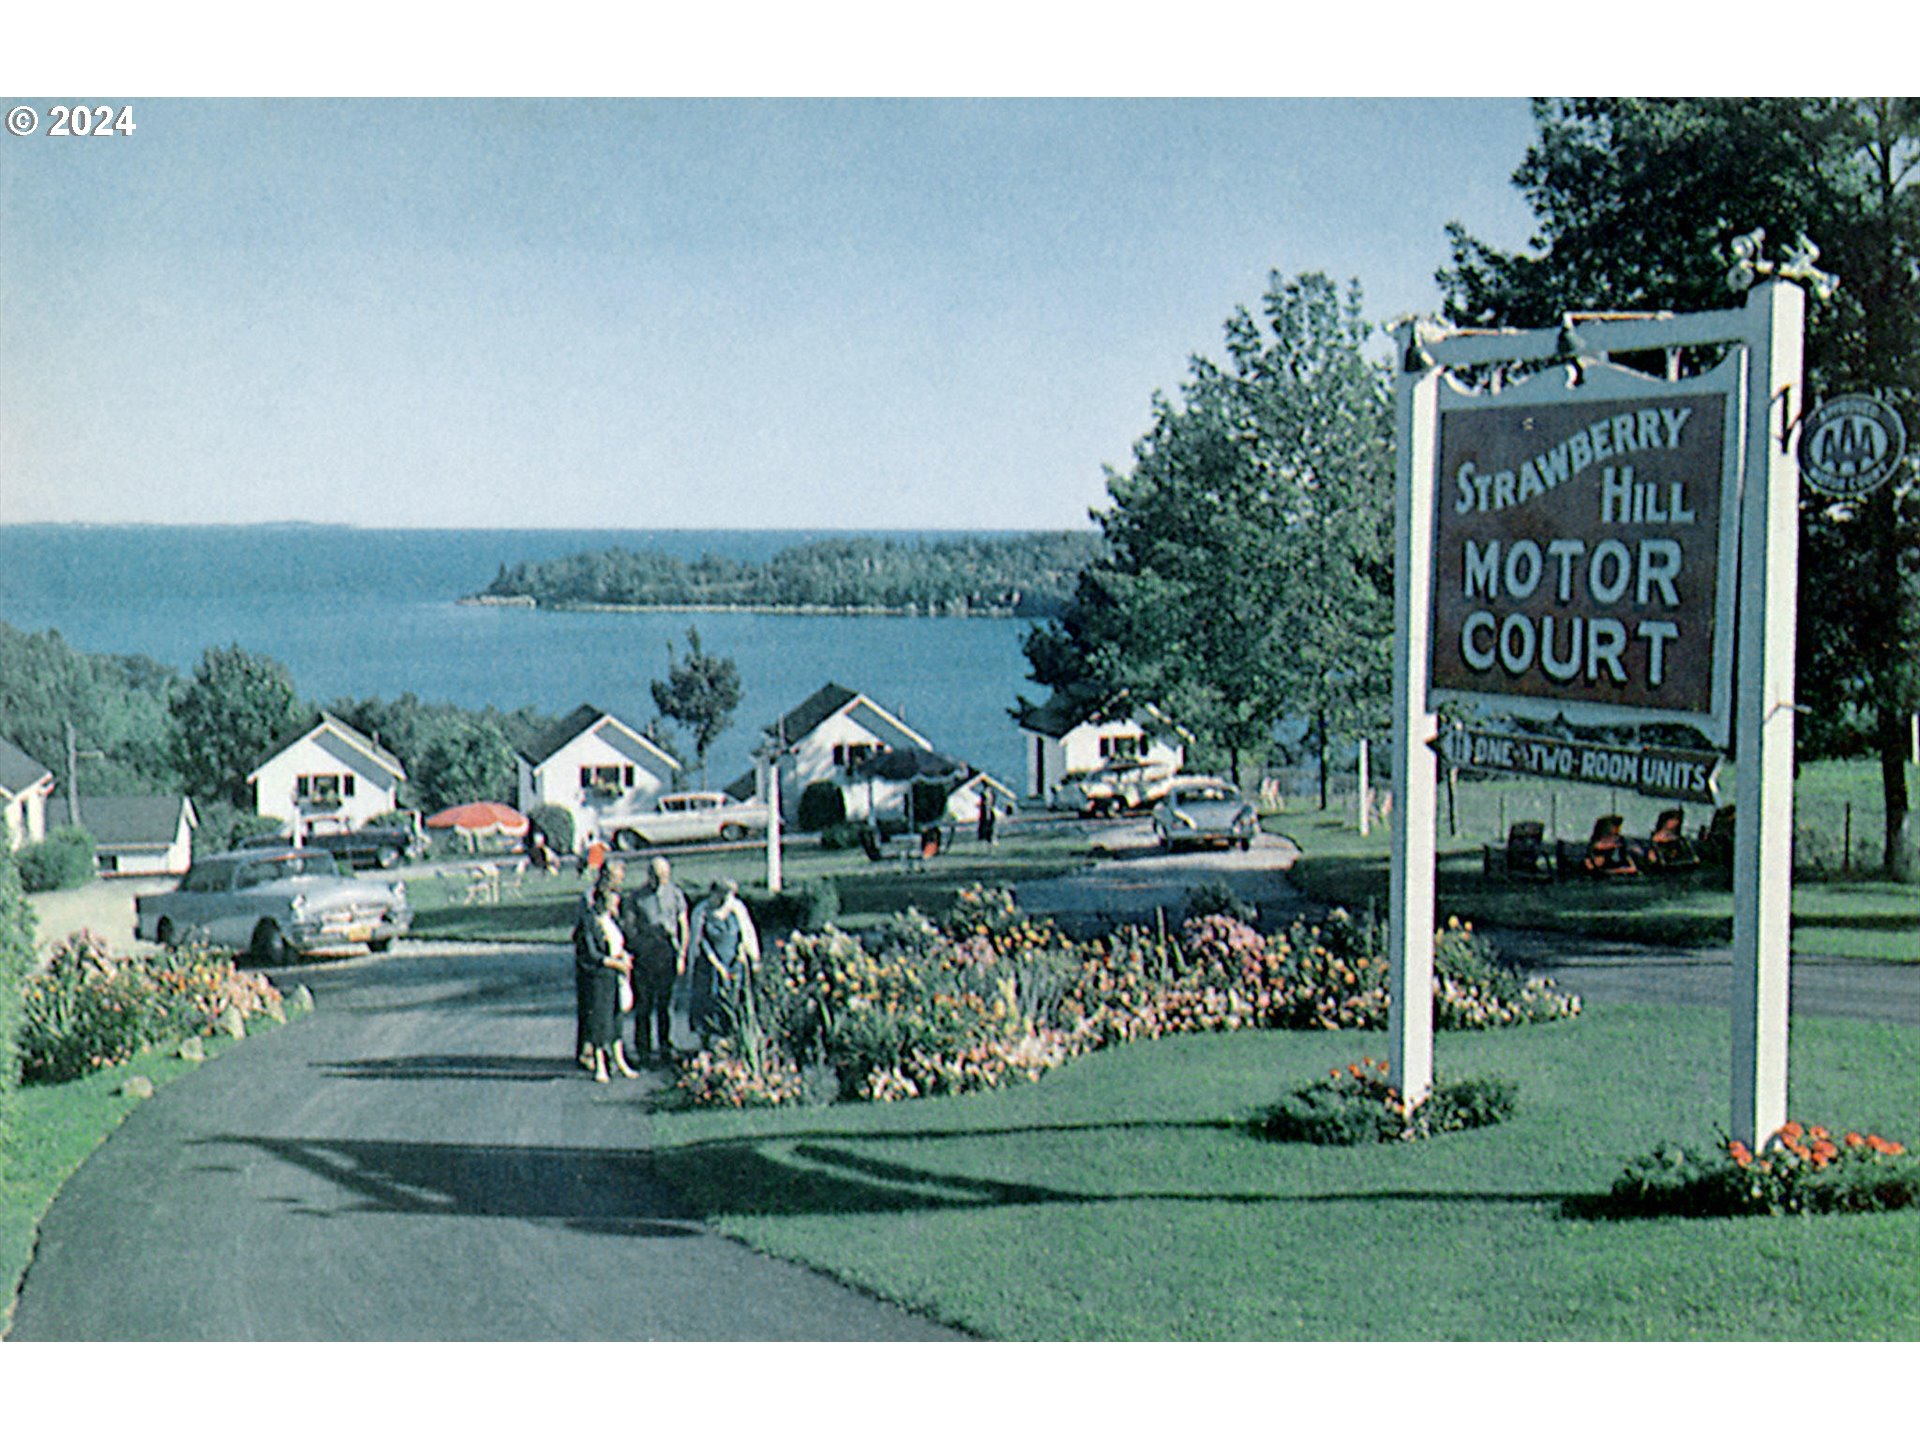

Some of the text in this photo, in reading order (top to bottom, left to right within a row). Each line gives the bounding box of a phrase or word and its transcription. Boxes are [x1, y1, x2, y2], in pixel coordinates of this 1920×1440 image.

[1455, 407, 1692, 515] STRAWBERRY
[1821, 418, 1876, 475] AAA
[1602, 465, 1695, 524] HILL
[1464, 539, 1682, 606] MOTOR
[1462, 610, 1679, 685] COURT
[1641, 757, 1706, 791] UNITS
